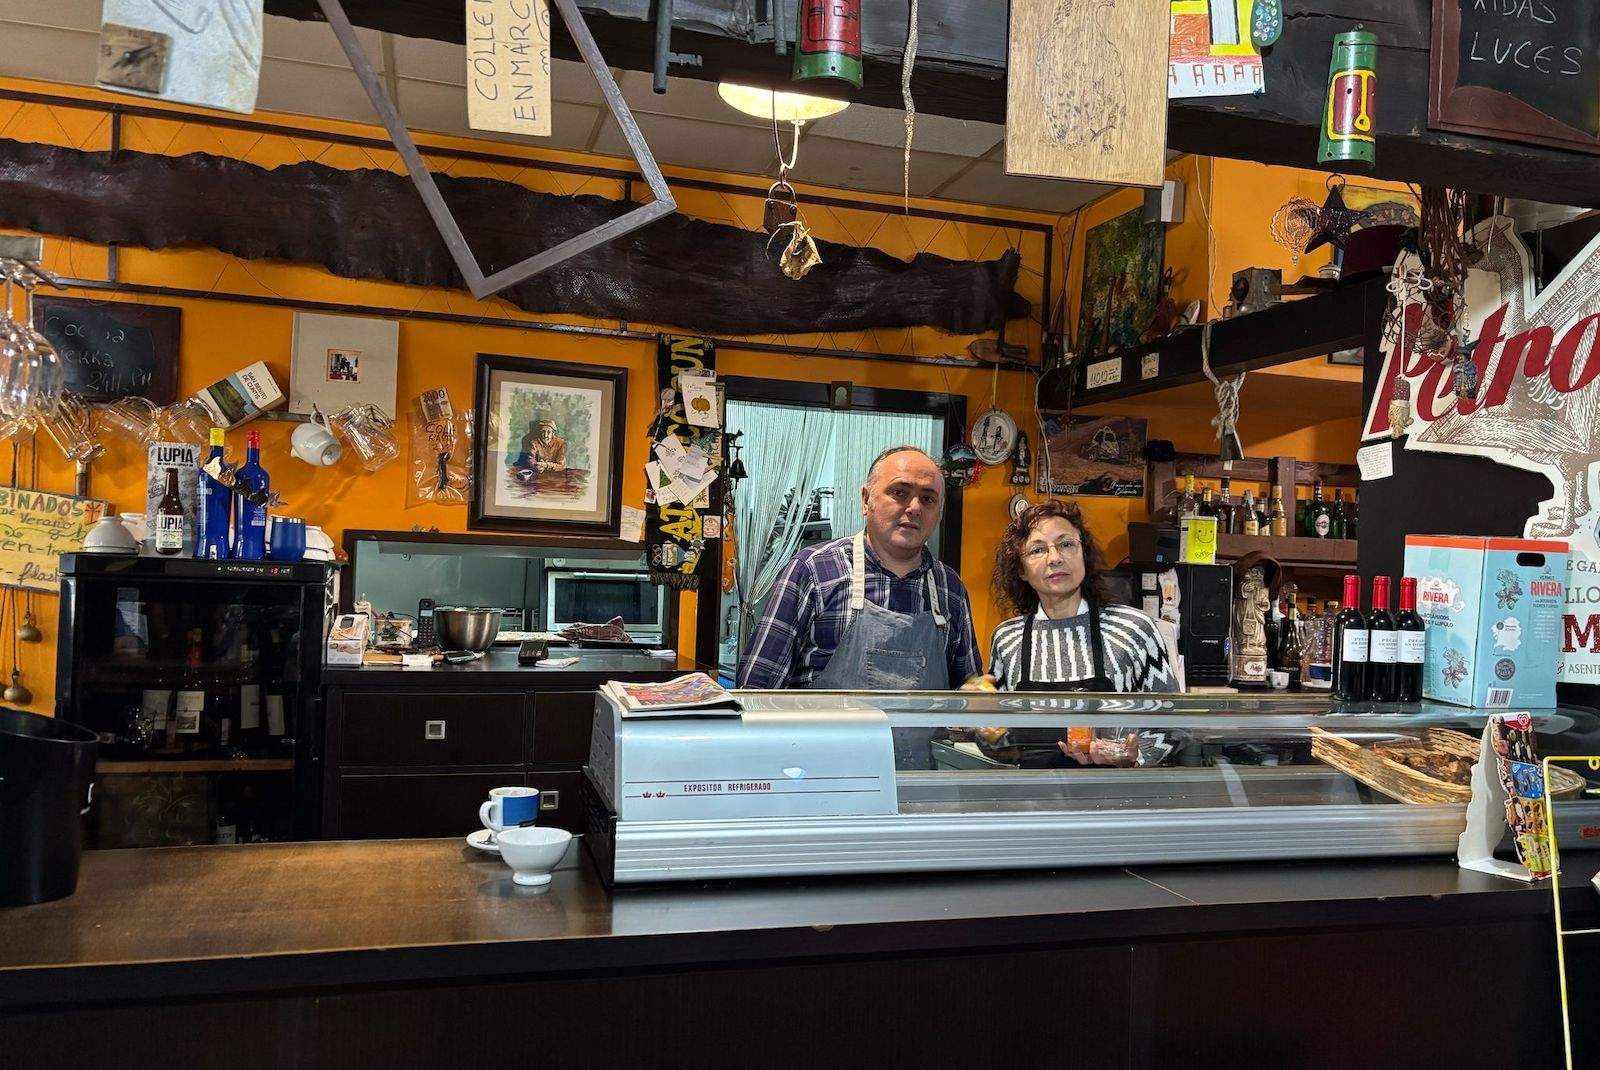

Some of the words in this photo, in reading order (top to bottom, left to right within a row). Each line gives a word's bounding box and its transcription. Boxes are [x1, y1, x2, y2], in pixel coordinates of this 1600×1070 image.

[1471, 31, 1583, 75] LUCES
[157, 446, 194, 464] LUPIA
[1423, 591, 1449, 604] RIVERA
[1530, 581, 1562, 598] RIVERA
[683, 783, 722, 792] EXPOSITOR
[728, 782, 771, 792] REFRIGERADO
